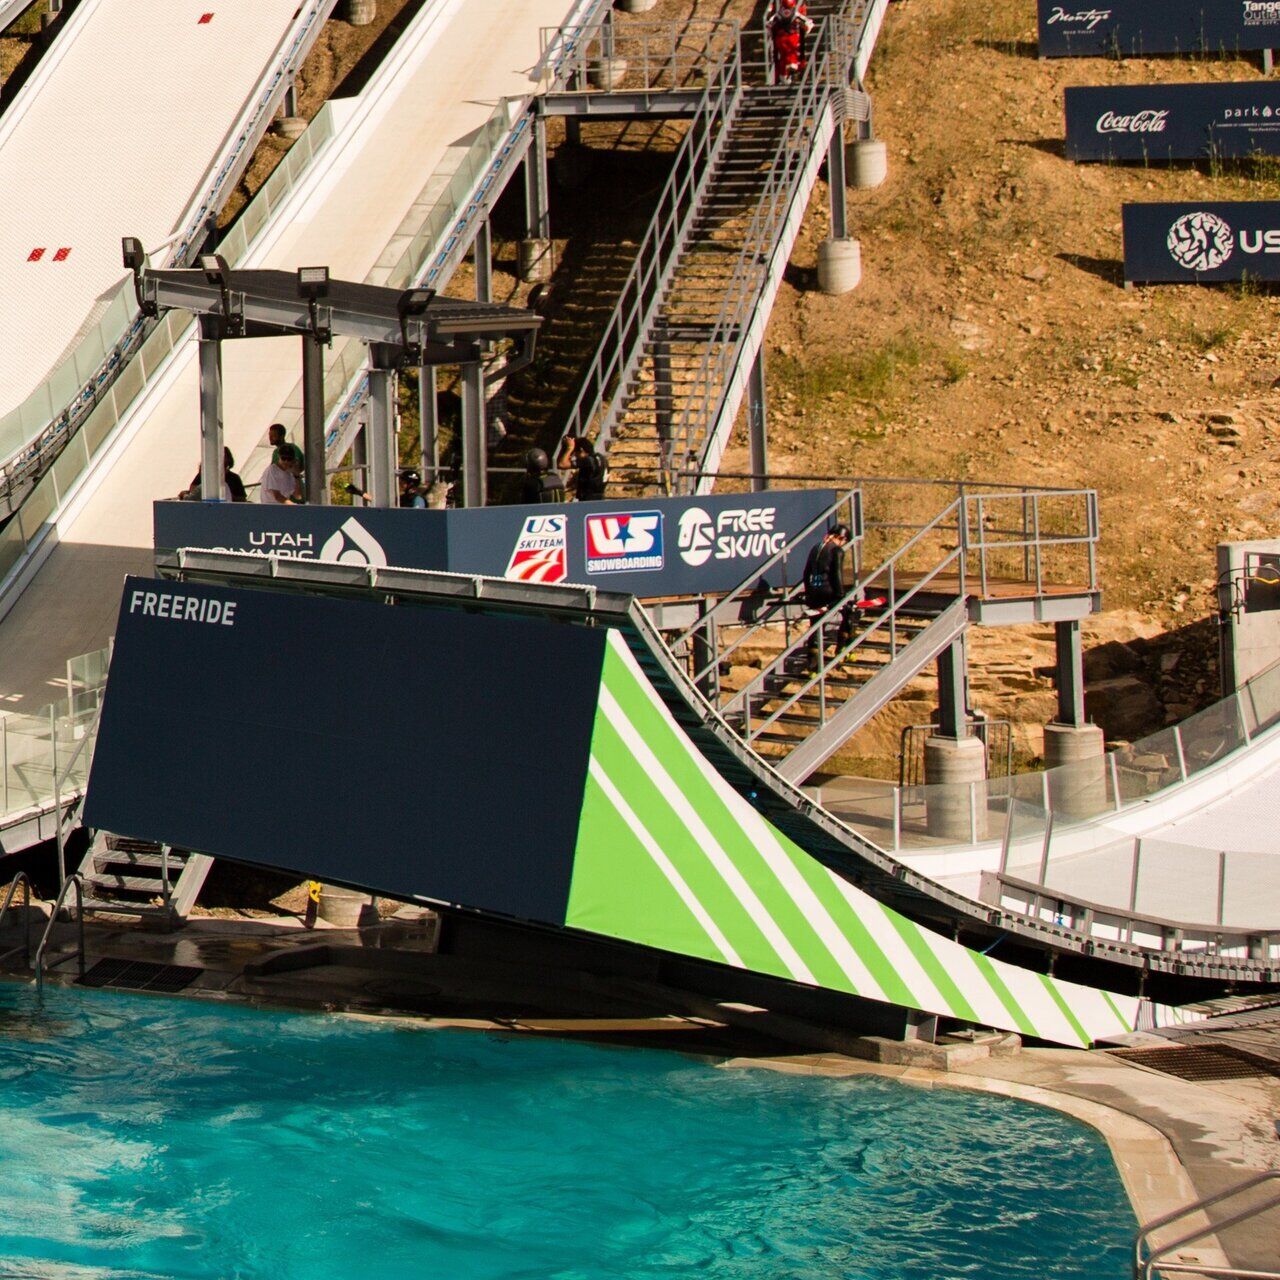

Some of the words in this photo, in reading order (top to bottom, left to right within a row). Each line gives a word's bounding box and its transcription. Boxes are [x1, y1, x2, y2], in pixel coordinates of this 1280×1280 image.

[1046, 6, 1113, 30] Montage
[1095, 109, 1171, 133] Coca-Cola
[1224, 105, 1259, 119] park
[526, 517, 563, 533] US
[717, 507, 776, 533] FREE
[249, 531, 313, 547] UTAH
[518, 538, 537, 549] SKI
[538, 537, 564, 548] TEAM
[588, 516, 659, 554] US
[587, 555, 663, 572] SNOWBOARDING
[129, 590, 237, 626] FREERIDE
